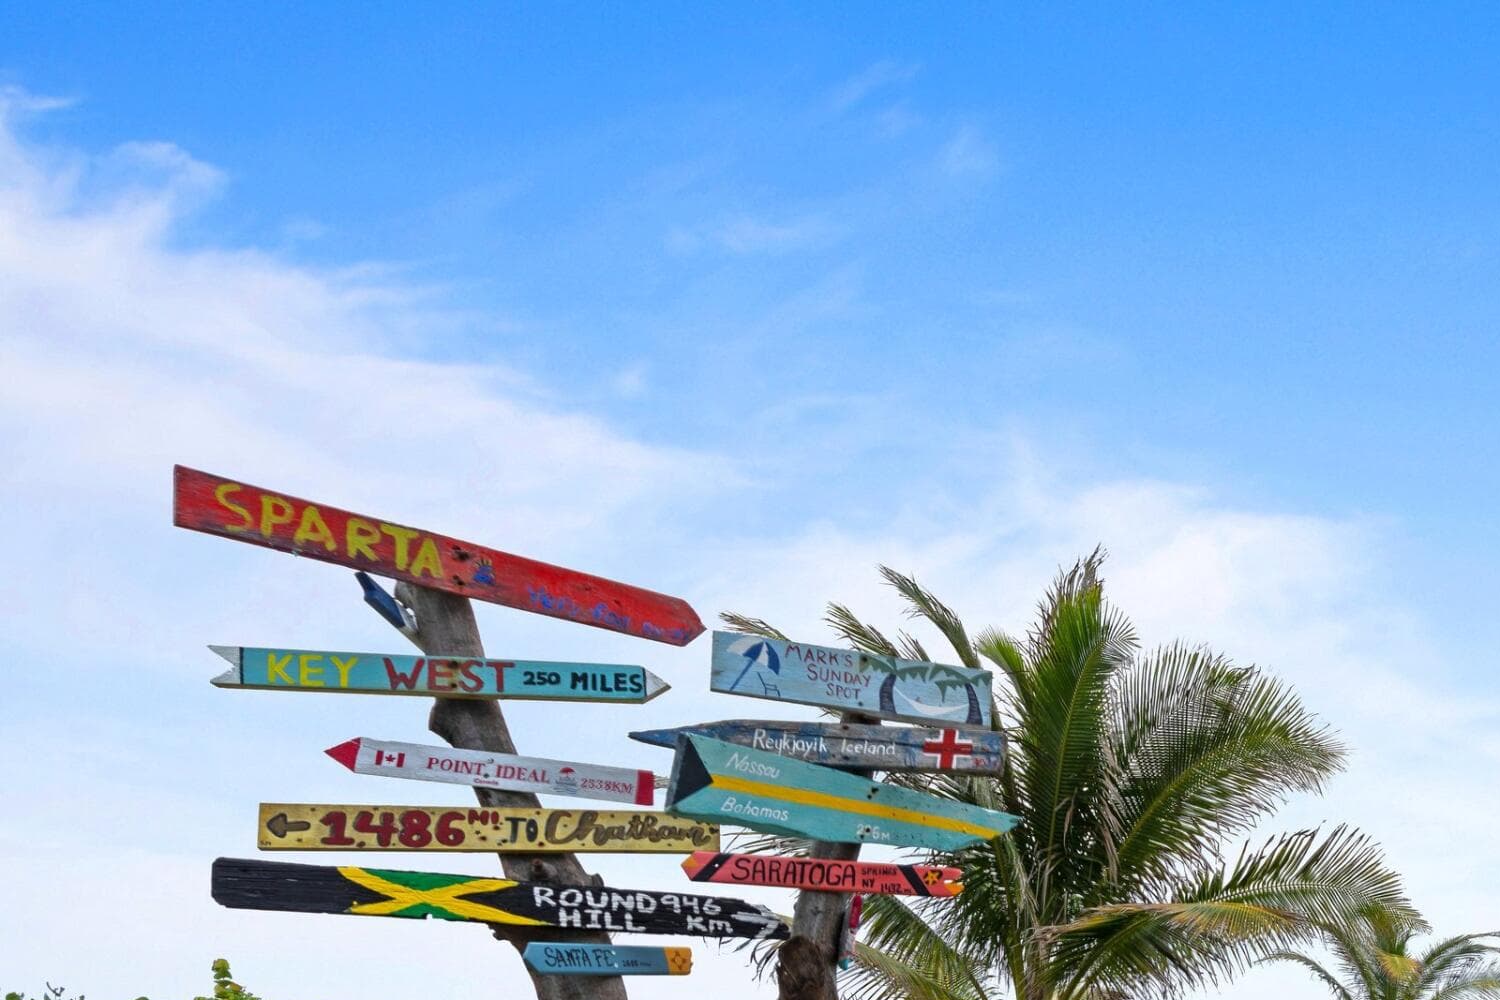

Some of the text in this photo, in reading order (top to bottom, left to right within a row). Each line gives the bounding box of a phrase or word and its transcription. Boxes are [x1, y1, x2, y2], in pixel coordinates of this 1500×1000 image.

[214, 482, 444, 578] SPARTA
[785, 644, 854, 667] MARK'S
[267, 653, 643, 693] KEY WEST 250 MILES
[807, 663, 871, 687] SUNDAY
[825, 682, 861, 700] SPOT
[840, 737, 896, 756] Iceland
[426, 756, 486, 776] POINT
[495, 764, 549, 784] IDEAL
[720, 796, 790, 822] Bahamas
[319, 809, 466, 848] 1486
[504, 816, 538, 844] TO
[731, 857, 856, 887] SARATOGA
[862, 879, 875, 889] NY
[532, 886, 723, 915] ROUND 946
[559, 908, 646, 932] HILL
[544, 946, 592, 968] SANTA
[592, 948, 614, 968] FE
